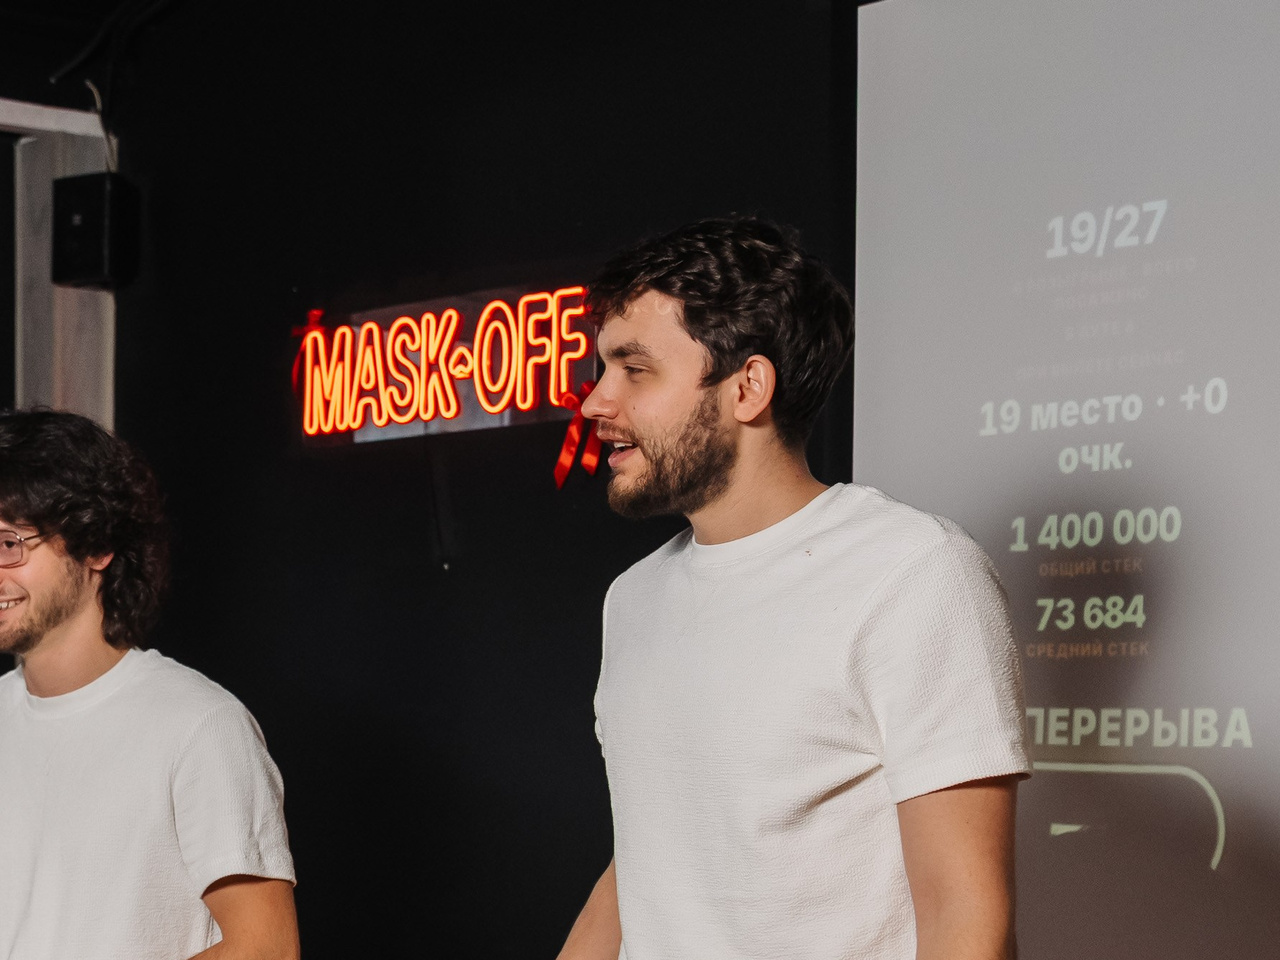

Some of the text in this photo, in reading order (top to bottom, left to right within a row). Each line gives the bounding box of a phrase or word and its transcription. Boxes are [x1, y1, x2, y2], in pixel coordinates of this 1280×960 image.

[1045, 200, 1168, 259] 19/27
[303, 286, 587, 435] MASK OFF
[979, 399, 1020, 437] 19
[1030, 394, 1143, 431] место
[1057, 442, 1132, 474] очк.
[1009, 505, 1182, 552] 1 400 000
[1038, 556, 1144, 578] ОБЩИЙ СТЕК
[1036, 594, 1146, 631] 73 684
[1026, 641, 1150, 660] СРЕДНИЙ СТЕК
